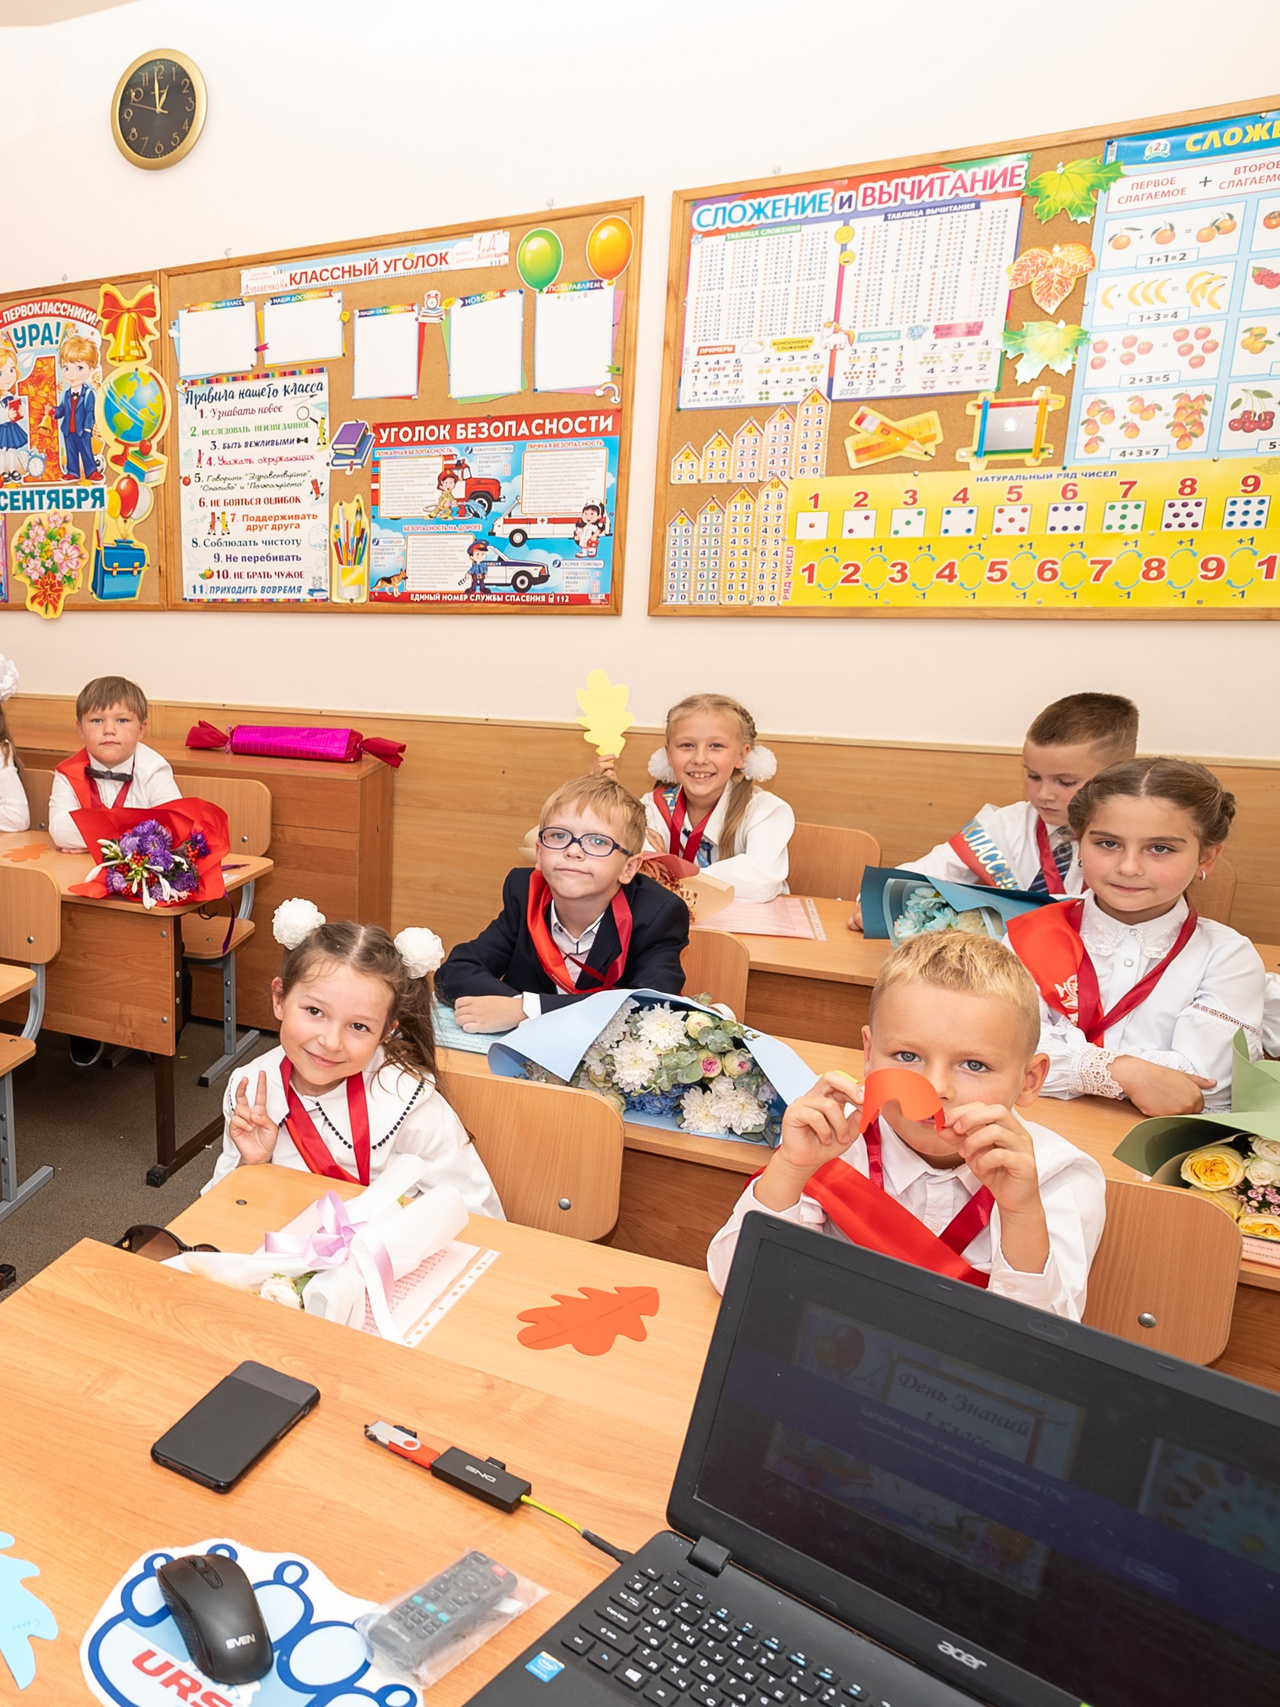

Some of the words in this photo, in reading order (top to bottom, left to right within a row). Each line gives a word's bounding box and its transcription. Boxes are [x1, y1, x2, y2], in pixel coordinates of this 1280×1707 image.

[140, 72, 148, 86] 11
[154, 65, 164, 80] 12
[172, 67, 176, 81] 1
[181, 78, 190, 94] 2
[130, 88, 144, 103] 10
[186, 98, 194, 111] 3
[124, 108, 133, 122] 9
[182, 118, 189, 132] 4
[130, 128, 138, 141] 8
[171, 132, 180, 146] 5
[142, 137, 149, 153] 7
[155, 140, 164, 154] 6
[1131, 176, 1177, 191] ПЕРВОЕ
[696, 192, 832, 228] СЛОЖЕНИЕ
[839, 195, 853, 210] и
[861, 164, 1025, 207] ВЫЧИТАНИЕ
[1118, 188, 1187, 205] СЛАГАЕМОЕ
[888, 210, 924, 220] ТАБЛИЦА
[926, 204, 975, 215] ВЫЧИТАНИЯ
[727, 230, 758, 240] ТАБЛИЦА
[761, 226, 800, 237] СЛОЖЕНИЯ
[1148, 252, 1187, 264] 1+1=2
[289, 257, 379, 286] КЛАССНЫЙ
[384, 251, 450, 274] УГОЛОК
[548, 282, 601, 292] ПОЗДРАВЛЯЕМ
[272, 296, 291, 304] НАШИ
[465, 292, 500, 305] НОВОСТИ
[3, 302, 99, 326] ПЕРВОКЛАССНИКИ!
[1138, 312, 1178, 322] 1+3=4
[13, 321, 61, 348] УРА!
[860, 332, 898, 340] ПРИМЕРЫ
[700, 346, 733, 354] ПРИМЕРЫ
[1129, 374, 1170, 385] 2+3=5
[185, 387, 235, 410] Правила
[238, 383, 279, 399] нашего
[283, 382, 324, 396] класса
[200, 409, 207, 419] 1.
[210, 406, 256, 420] Узнавать
[258, 404, 283, 414] новое
[190, 426, 199, 437] 2.
[202, 426, 250, 436] ИССЛЕДОВАТЬ
[254, 422, 310, 432] НЕИЗВЕДАННОЕ
[379, 424, 451, 444] УГОЛОК
[456, 415, 613, 440] БЕЗОПАСНОСТИ
[210, 441, 220, 451] 3.
[222, 441, 242, 450] БЫТЬ
[244, 438, 295, 448] ВЕЖЛИВЫМИ
[551, 440, 603, 448] БЕЗОПАСНОСТЬ
[206, 457, 216, 466] 4.
[218, 455, 254, 465] Уважать
[258, 454, 315, 465] окружающих
[1120, 448, 1159, 458] 4+3=7
[194, 473, 204, 483] 5.
[206, 474, 242, 483] Говорить
[976, 470, 1053, 483] НАТУРАЛЬНЫЙ
[1056, 471, 1077, 480] РЯД
[1081, 470, 1117, 479] ЧИСЕЛ
[809, 493, 820, 509] 1
[853, 492, 869, 507] 2
[903, 490, 918, 505] 3
[952, 488, 970, 504] 4
[1006, 486, 1023, 502] 5
[1061, 482, 1079, 500] 6
[1120, 480, 1138, 499] 7
[1178, 478, 1198, 496] 8
[1241, 475, 1261, 493] 9
[198, 498, 208, 507] 6.
[210, 499, 221, 507] НЕ
[224, 498, 262, 507] БОЯТЬСЯ
[264, 496, 301, 505] ОШИБОК
[230, 513, 239, 523] 7.
[242, 514, 318, 523] Поддерживать
[246, 524, 269, 532] друг
[271, 522, 301, 532] друга
[458, 524, 482, 532] ДОРОГЕ
[192, 538, 201, 548] 8.
[204, 538, 259, 548] Соблюдать
[262, 538, 302, 548] чистоту
[214, 552, 223, 563] 9.
[226, 554, 239, 563] Не
[241, 553, 302, 564] перебивать
[785, 546, 794, 578] ЧИСЕЛ
[216, 570, 231, 580] 10.
[234, 571, 244, 579] НЕ
[247, 571, 273, 579] БРАТЬ
[274, 570, 305, 579] ЧУЖОЕ
[192, 584, 207, 594] 11.
[209, 586, 258, 595] ПРИХОДИТЬ
[260, 586, 302, 594] ВОВРЕМЯ
[783, 581, 792, 600] РЯД
[410, 594, 440, 602] ЕДИНЫЙ
[442, 594, 468, 602] НОМЕР
[470, 593, 503, 603] СЛУЖБЫ
[505, 594, 546, 603] СПАСЕНИЯ
[557, 594, 570, 603] 112
[900, 1372, 948, 1403] День
[952, 1394, 1029, 1437] Знаний
[226, 1634, 256, 1650] SVEN
[938, 1640, 987, 1670] acer
